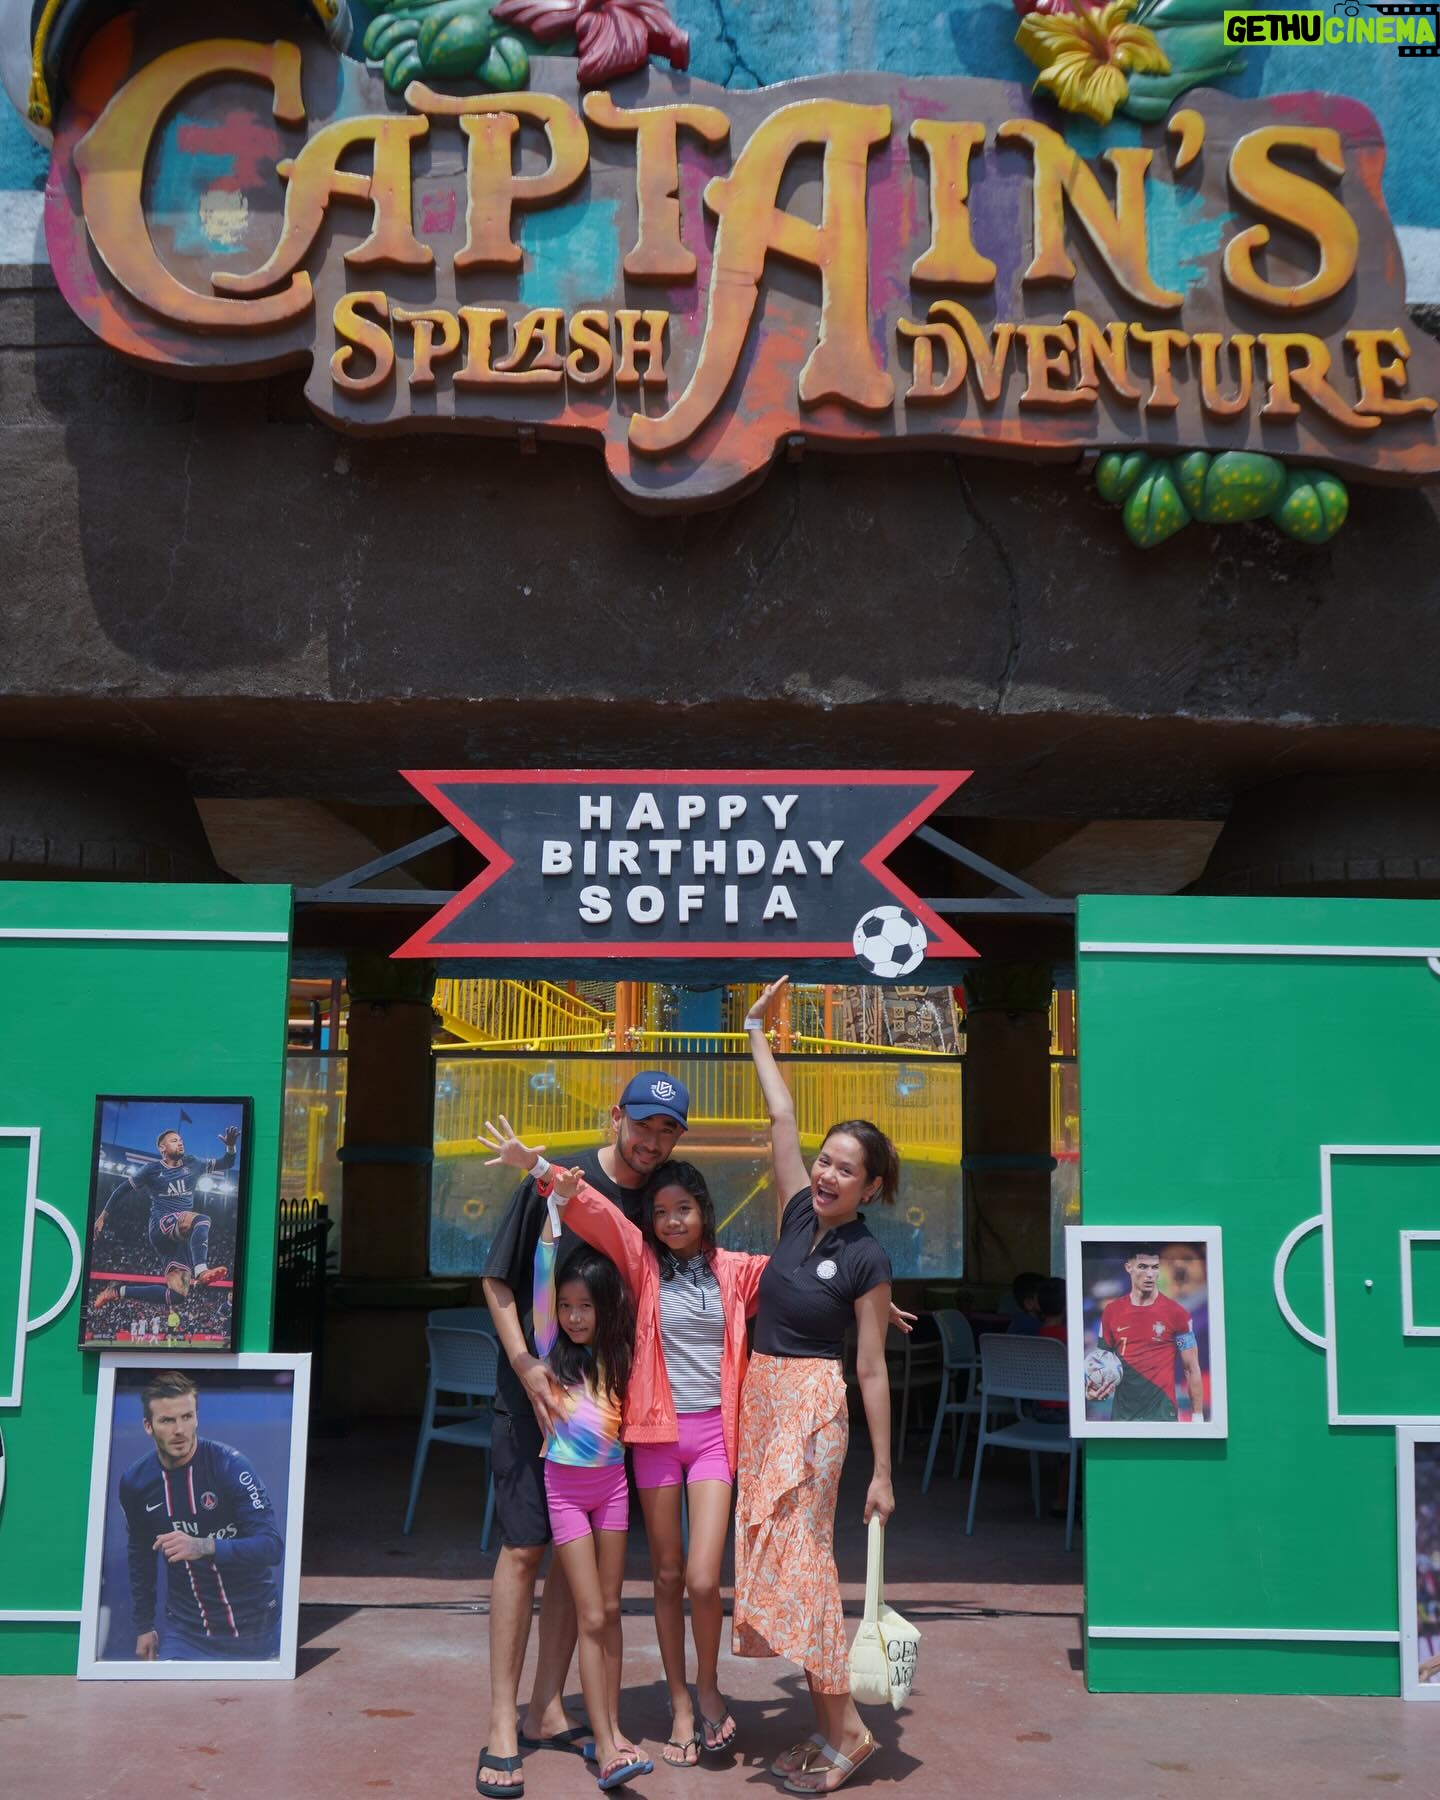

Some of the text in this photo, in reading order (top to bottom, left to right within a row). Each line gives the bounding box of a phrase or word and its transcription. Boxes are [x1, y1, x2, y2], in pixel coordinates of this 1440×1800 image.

[73, 37, 1360, 456] CAPTAIN'S
[330, 290, 670, 394] SPLASH
[579, 791, 799, 830] HAPPY
[540, 839, 845, 876] BIRTHDAY
[578, 884, 798, 923] SOFIA
